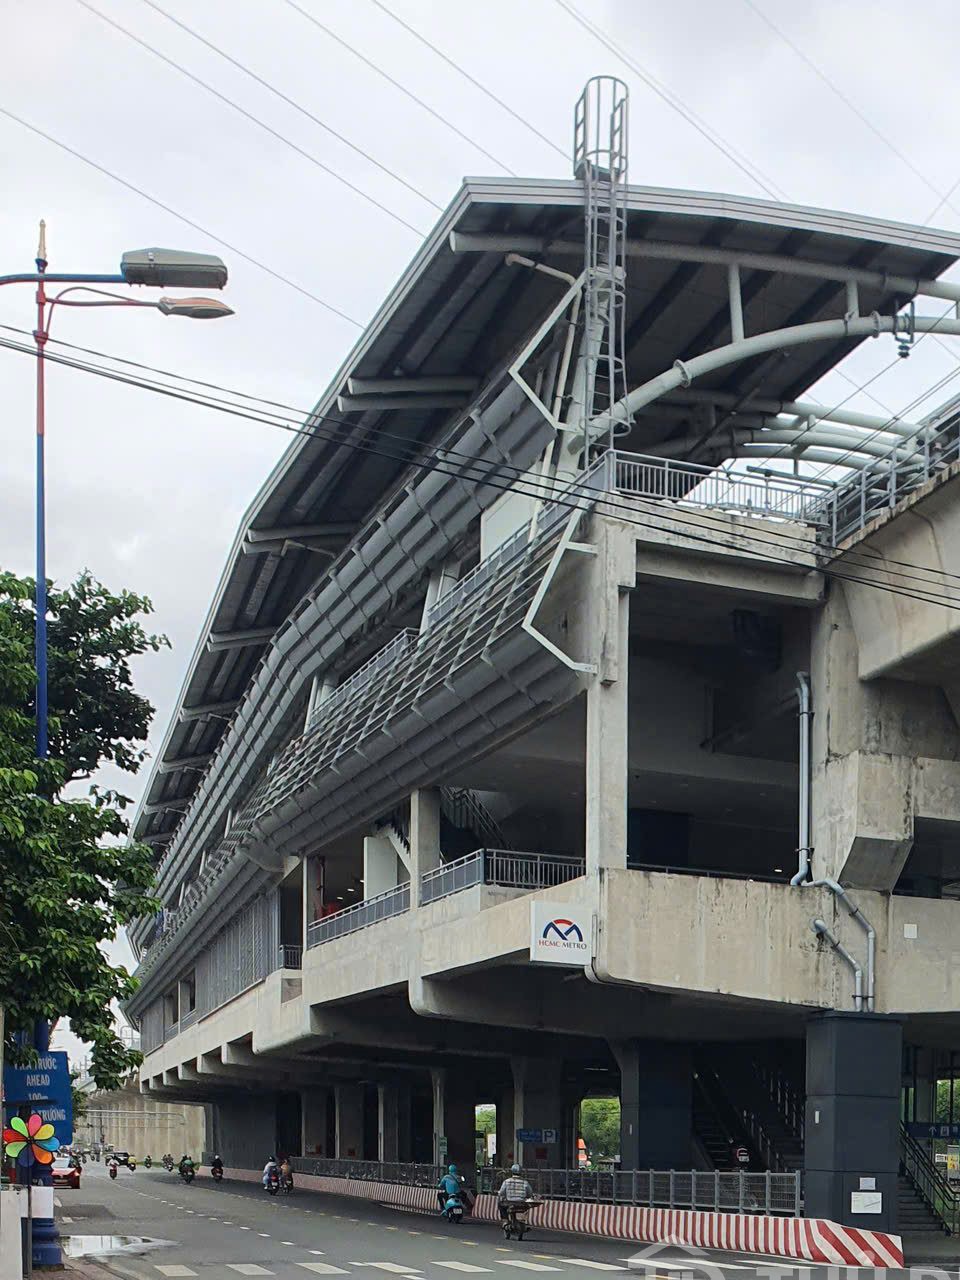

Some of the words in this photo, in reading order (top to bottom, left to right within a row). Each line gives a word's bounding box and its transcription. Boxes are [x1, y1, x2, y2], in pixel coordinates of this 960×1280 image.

[538, 940, 560, 948] HCMC
[562, 942, 587, 950] METRO
[26, 1073, 50, 1087] AHEAD
